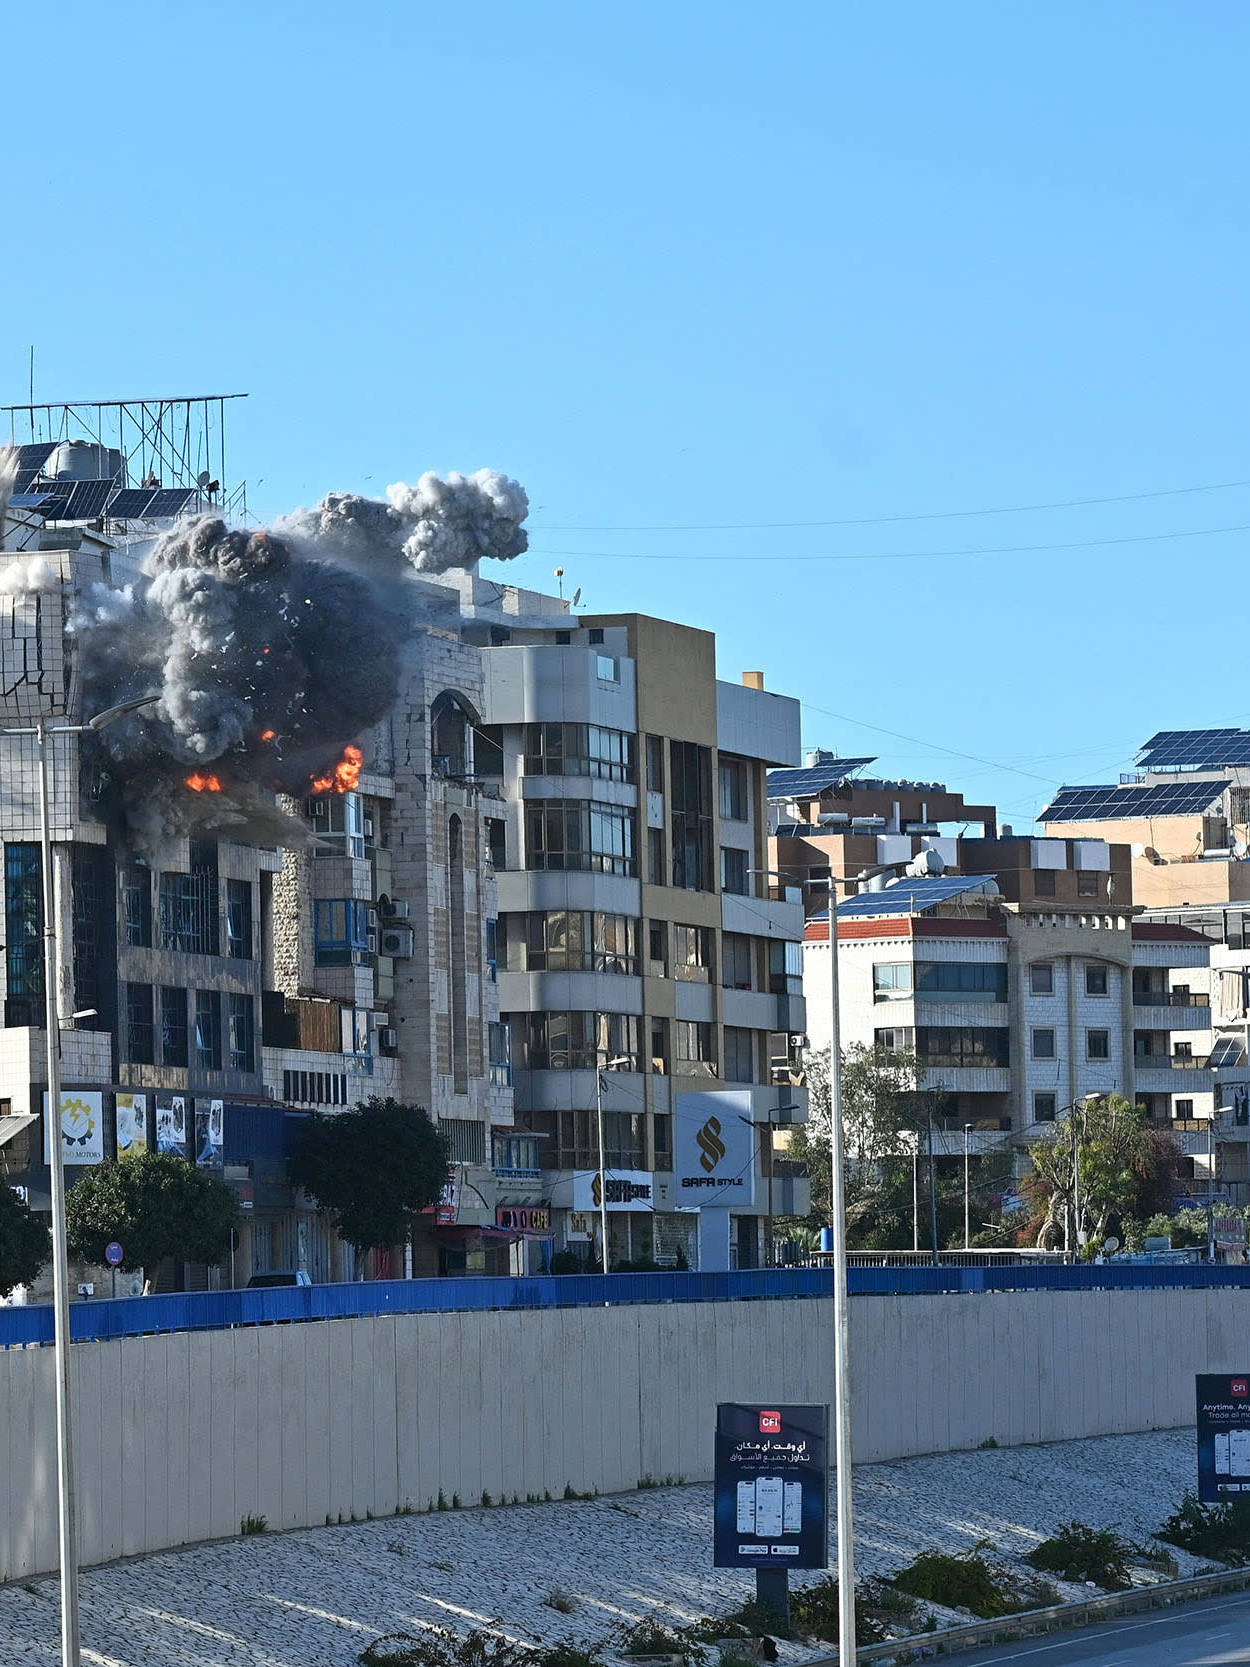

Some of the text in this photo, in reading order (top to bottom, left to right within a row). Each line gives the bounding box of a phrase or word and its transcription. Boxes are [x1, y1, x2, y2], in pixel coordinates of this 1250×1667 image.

[681, 1178, 743, 1188] SAFA STYLE
[1202, 1403, 1236, 1412] Anytime.
[762, 1417, 778, 1427] CFI
[761, 1440, 770, 1452] أي
[796, 1440, 806, 1453] أي
